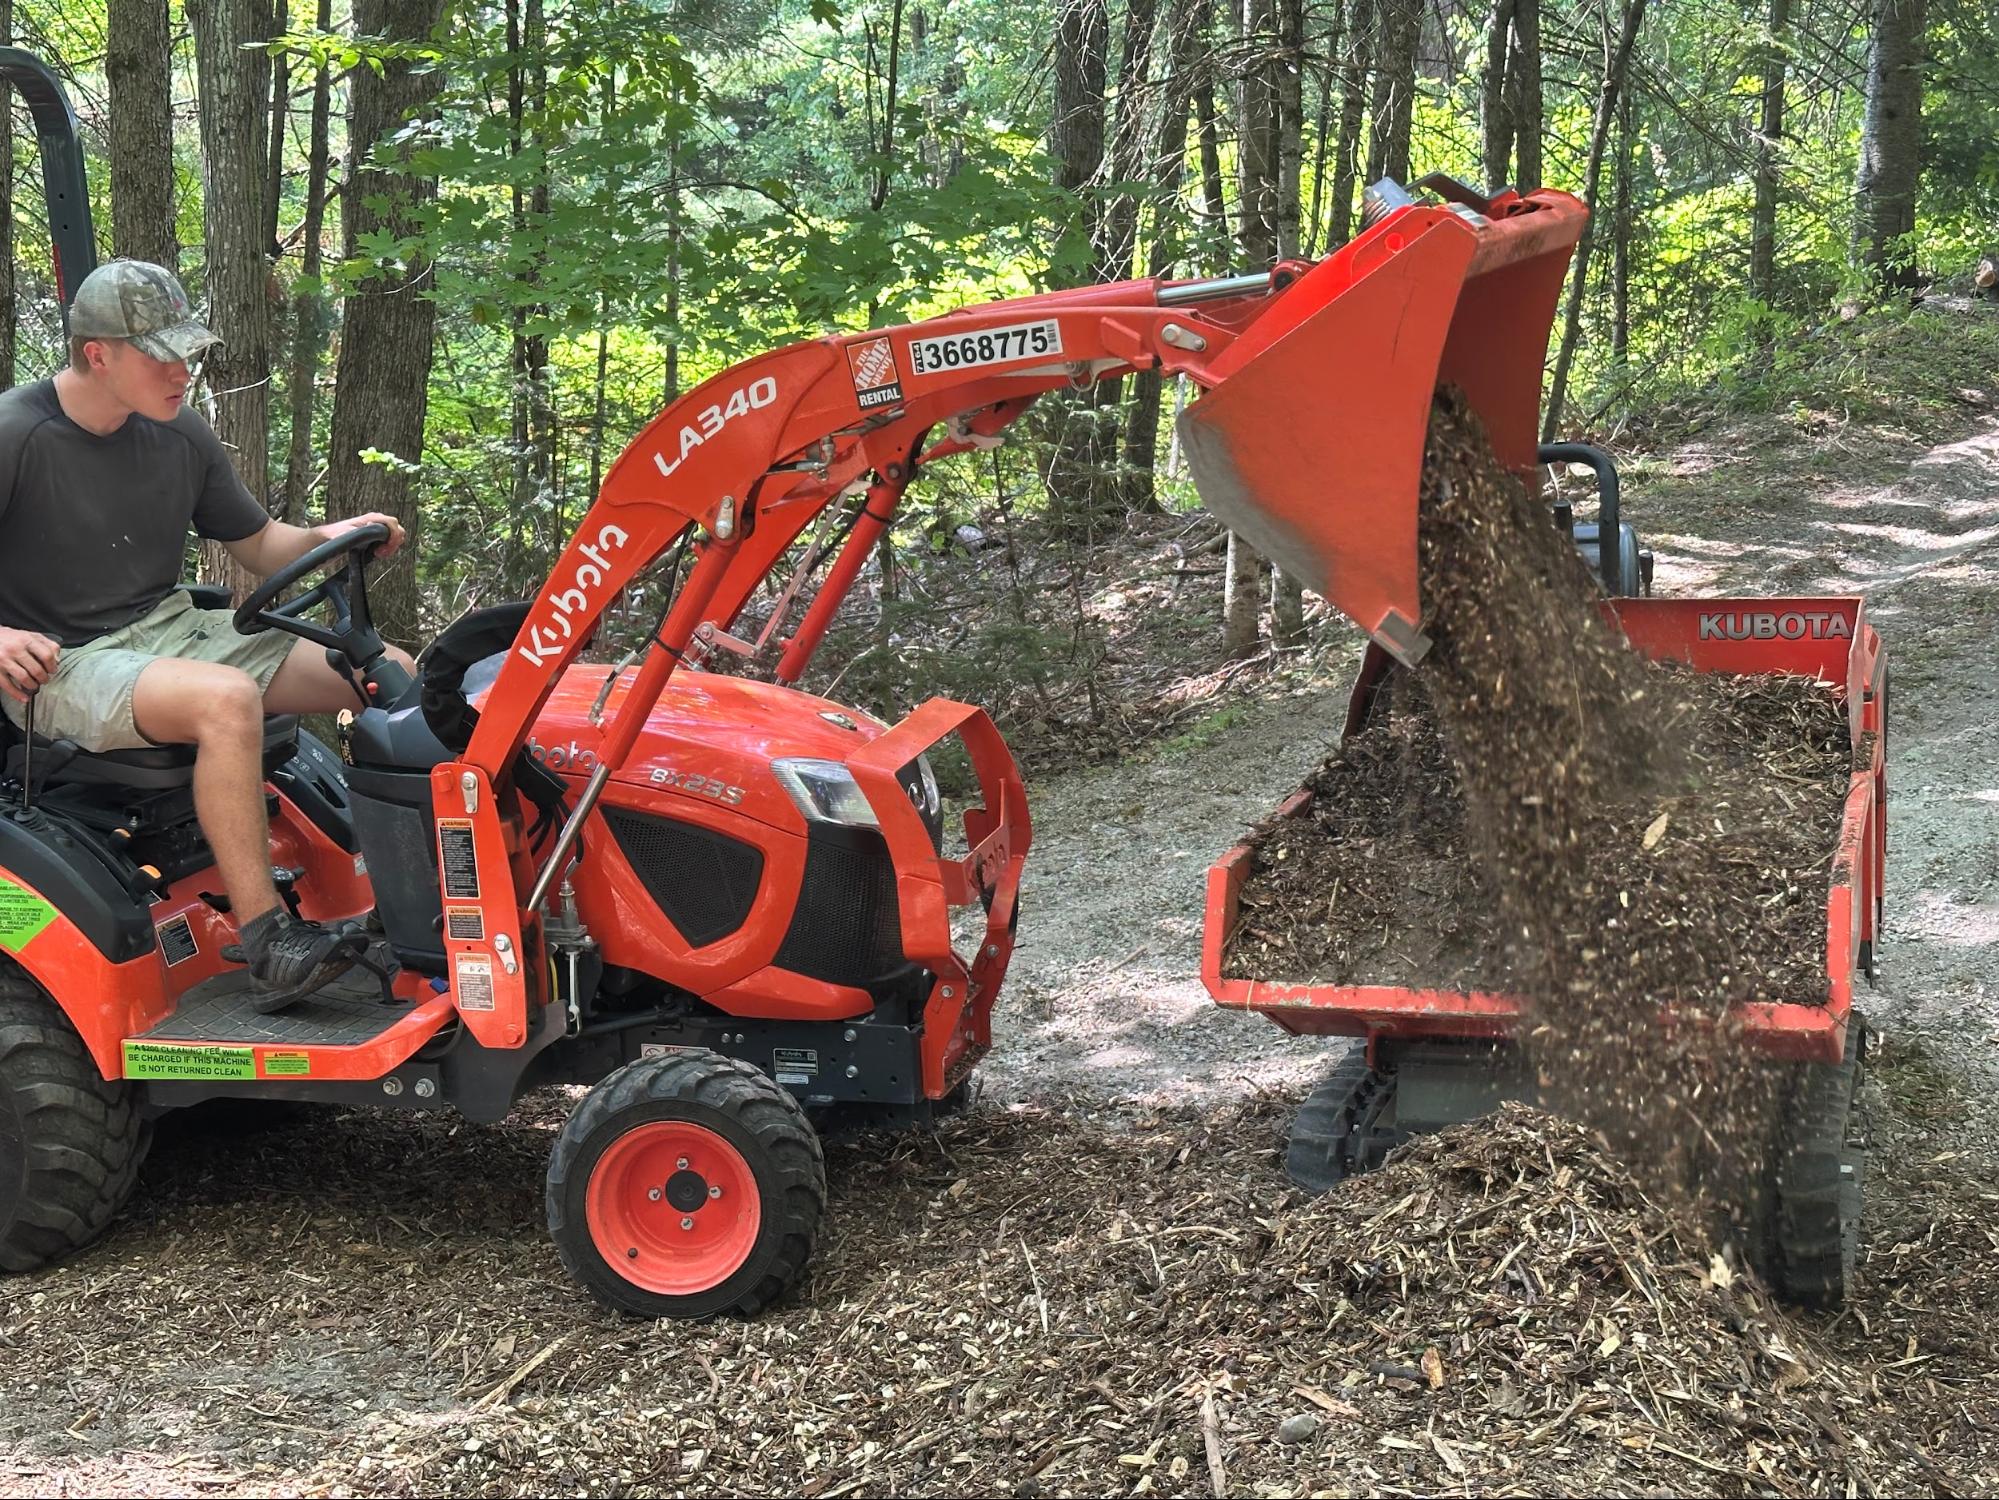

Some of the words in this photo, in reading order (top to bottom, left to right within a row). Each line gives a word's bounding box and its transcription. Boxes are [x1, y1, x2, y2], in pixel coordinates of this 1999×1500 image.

[855, 340, 889, 388] HOME
[856, 347, 871, 367] THE
[925, 326, 1048, 369] 3668775
[872, 353, 892, 386] DEPOT
[859, 388, 901, 406] RENTAL
[653, 377, 777, 477] LA340
[519, 525, 629, 667] Kubota
[1700, 612, 1852, 640] KUBOTA
[530, 737, 596, 770] bota
[650, 768, 747, 804] BX23S
[141, 1054, 181, 1063] CHARGED
[194, 1056, 211, 1064] THIS
[213, 1057, 252, 1066] MACHINE
[161, 1046, 202, 1055] CLEANING
[204, 1047, 219, 1055] FEE
[149, 1065, 166, 1073] NOT
[168, 1065, 212, 1075] RETURNED
[214, 1067, 242, 1076] CLEAN
